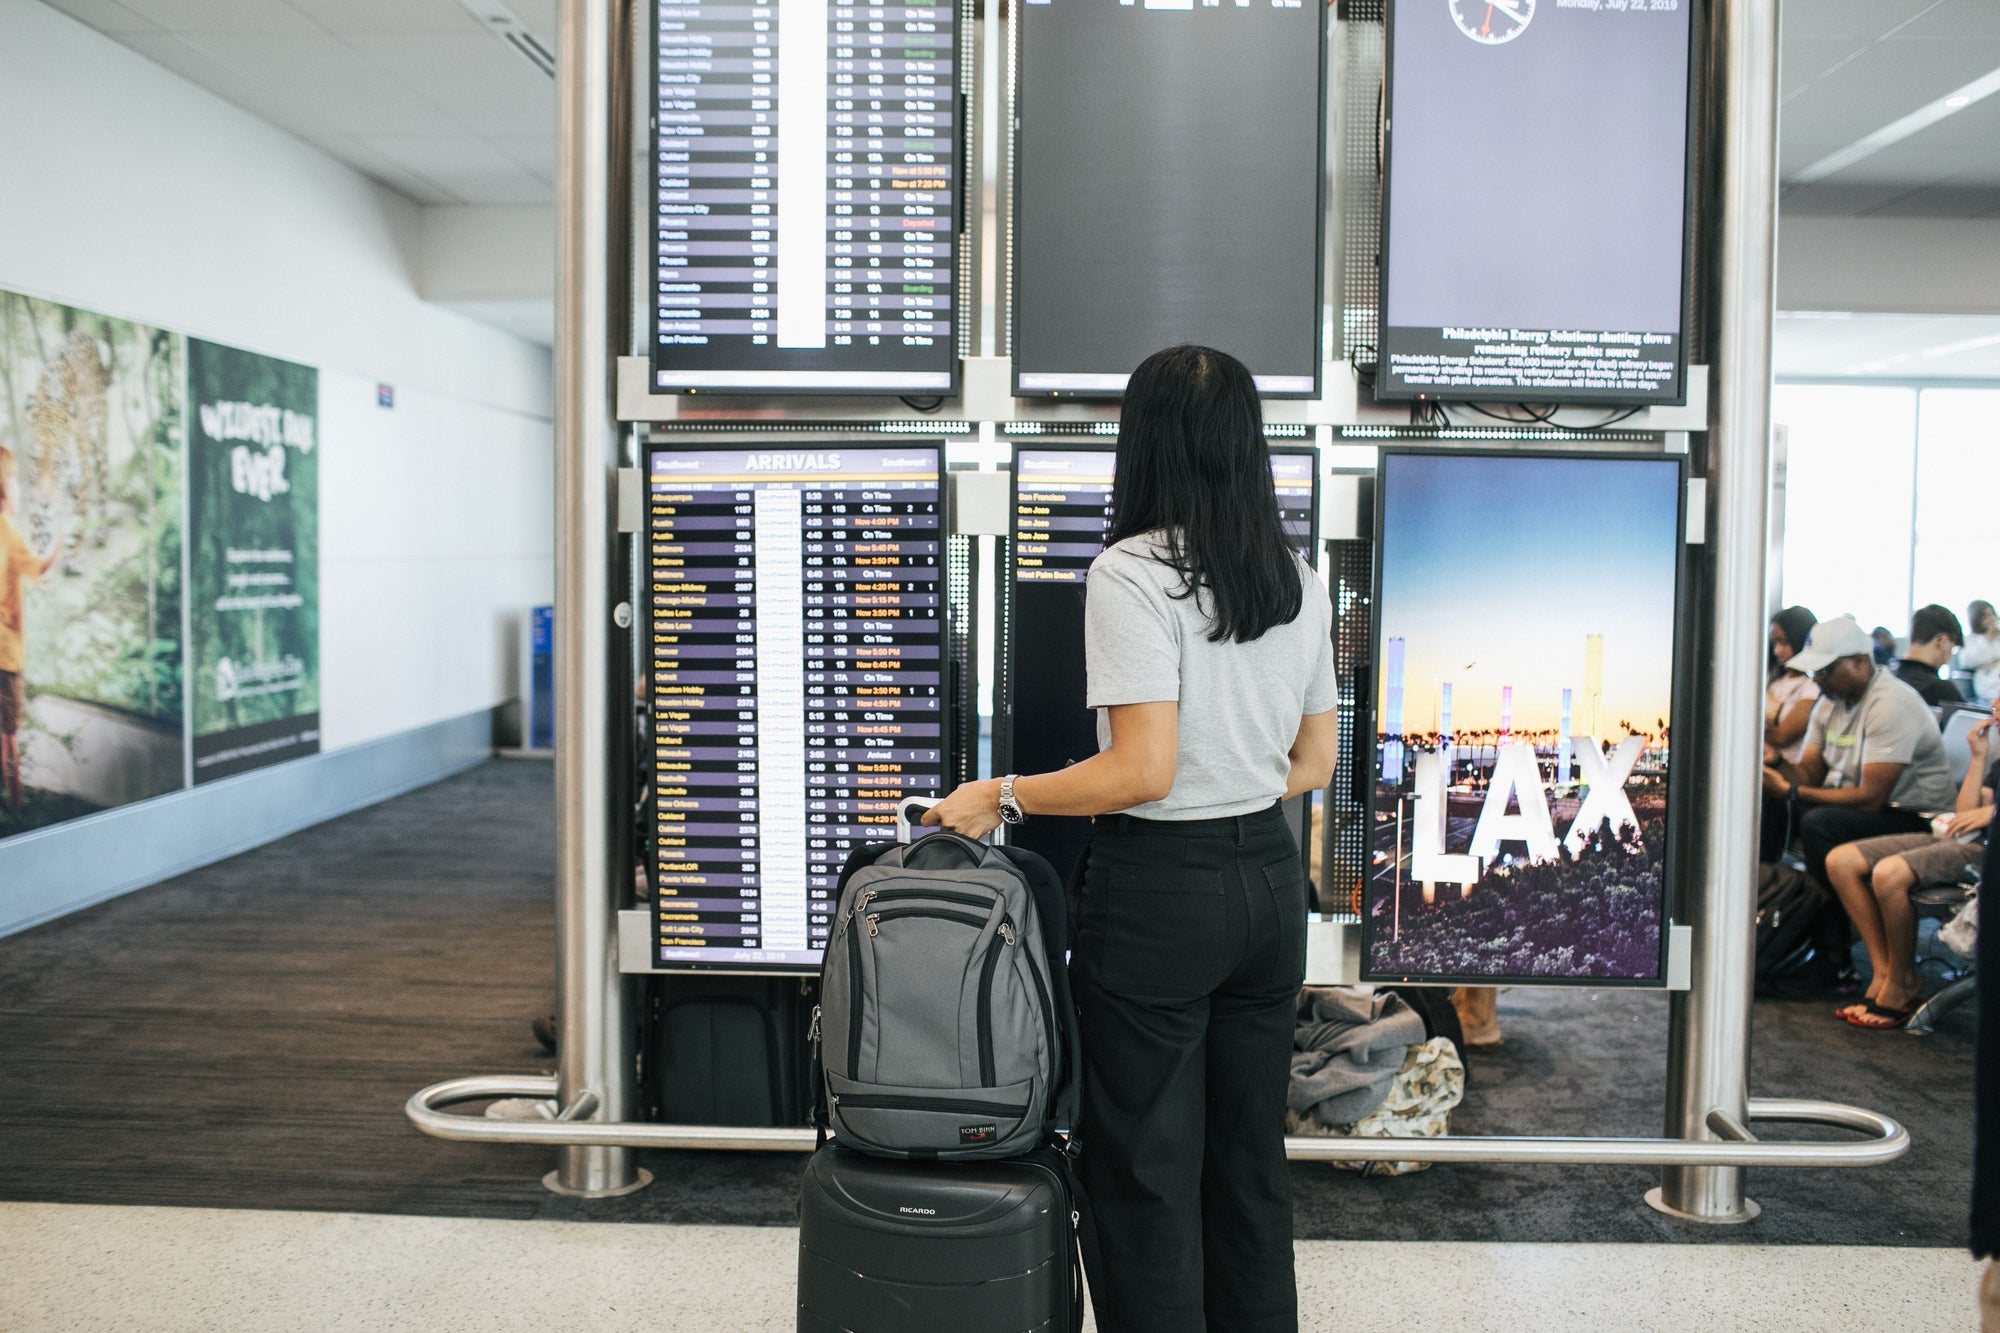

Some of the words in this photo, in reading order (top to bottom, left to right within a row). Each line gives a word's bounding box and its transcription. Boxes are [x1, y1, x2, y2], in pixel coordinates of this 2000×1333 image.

[1556, 0, 1602, 11] Monday,
[1606, 0, 1628, 12] July
[1630, 0, 1647, 11] 22,
[1650, 0, 1678, 11] 2019
[1442, 328, 1508, 342] Philadelphia
[1510, 328, 1548, 344] Energy
[1550, 330, 1598, 342] Solutions
[1599, 332, 1641, 346] shutting
[1643, 333, 1672, 344] down
[1474, 343, 1528, 357] remaining
[1529, 344, 1572, 358] refinery
[1574, 345, 1603, 357] units:
[1605, 348, 1640, 358] source
[1390, 354, 1438, 365] Philadelphia
[1440, 355, 1468, 366] Energy
[1619, 360, 1647, 371] refinery
[1648, 360, 1673, 371] began
[1484, 367, 1523, 377] remaining
[1524, 368, 1553, 378] refinery
[1554, 369, 1573, 377] units
[1620, 370, 1637, 379] said
[1645, 372, 1671, 380] source
[1516, 377, 1531, 386] The
[656, 460, 698, 470] Southwest
[746, 454, 841, 470] ARRIVALS
[882, 458, 926, 467] Southwest
[862, 492, 873, 500] On
[874, 492, 892, 500] Time
[1033, 494, 1066, 502] Francisco
[652, 506, 675, 515] Atlanta
[862, 505, 873, 513] On
[874, 505, 892, 513] Time
[1018, 506, 1032, 514] San
[1033, 506, 1050, 514] Jose
[652, 519, 673, 527] Austin
[855, 518, 870, 526] Now
[871, 518, 886, 526] 4:00
[887, 518, 899, 526] PM
[1033, 520, 1050, 528] Jose
[653, 532, 673, 540] Austin
[862, 531, 874, 539] On
[874, 531, 892, 539] Time
[1018, 532, 1032, 540] San
[1033, 532, 1050, 540] Jose
[653, 544, 684, 553] Baltimore
[855, 544, 870, 552] Now
[871, 544, 886, 552] 5:40
[887, 544, 899, 552] PM
[1017, 545, 1027, 553] St.
[1028, 545, 1047, 553] Louis
[653, 557, 684, 566] Baltimore
[855, 557, 871, 565] Now
[872, 557, 886, 565] 3:50
[888, 557, 900, 565] PM
[1017, 558, 1042, 566] Tucson
[653, 570, 684, 579] Baltimore
[863, 570, 874, 578] On
[875, 570, 892, 578] Time
[1017, 571, 1035, 579] West
[1036, 571, 1053, 579] Palm
[855, 583, 871, 591] Now
[872, 583, 887, 591] 4:20
[888, 583, 900, 591] PM
[856, 596, 871, 604] Now
[872, 596, 887, 604] 5:15
[888, 596, 900, 604] PM
[654, 609, 673, 617] Dallas
[675, 609, 692, 617] Love
[654, 621, 673, 630] Dallas
[675, 621, 692, 630] Love
[655, 634, 678, 643] Denver
[655, 647, 678, 656] Denver
[655, 660, 678, 668] Denver
[656, 686, 682, 694] Houston
[683, 686, 704, 696] Hobby
[656, 698, 682, 707] Houston
[683, 698, 704, 709] Hobby
[656, 711, 668, 720] Las
[669, 711, 690, 722] Vegas
[656, 724, 668, 732] Las
[669, 724, 690, 734] Vegas
[867, 751, 891, 759] Arrived
[657, 774, 687, 783] Nashville
[657, 787, 687, 795] Nashville
[658, 799, 672, 808] New
[1412, 736, 1648, 883] LAX
[658, 812, 685, 821] Oakland
[658, 825, 685, 833] Oakland
[658, 837, 685, 846] Oakland
[659, 888, 677, 896] Reno
[660, 925, 672, 934] Salt
[674, 925, 688, 934] Lake
[690, 925, 704, 936] City
[660, 938, 673, 946] San
[675, 938, 706, 946] Francisco
[734, 952, 750, 961] July
[979, 1126, 995, 1134] BIHN
[900, 1206, 936, 1215] RICARDO
